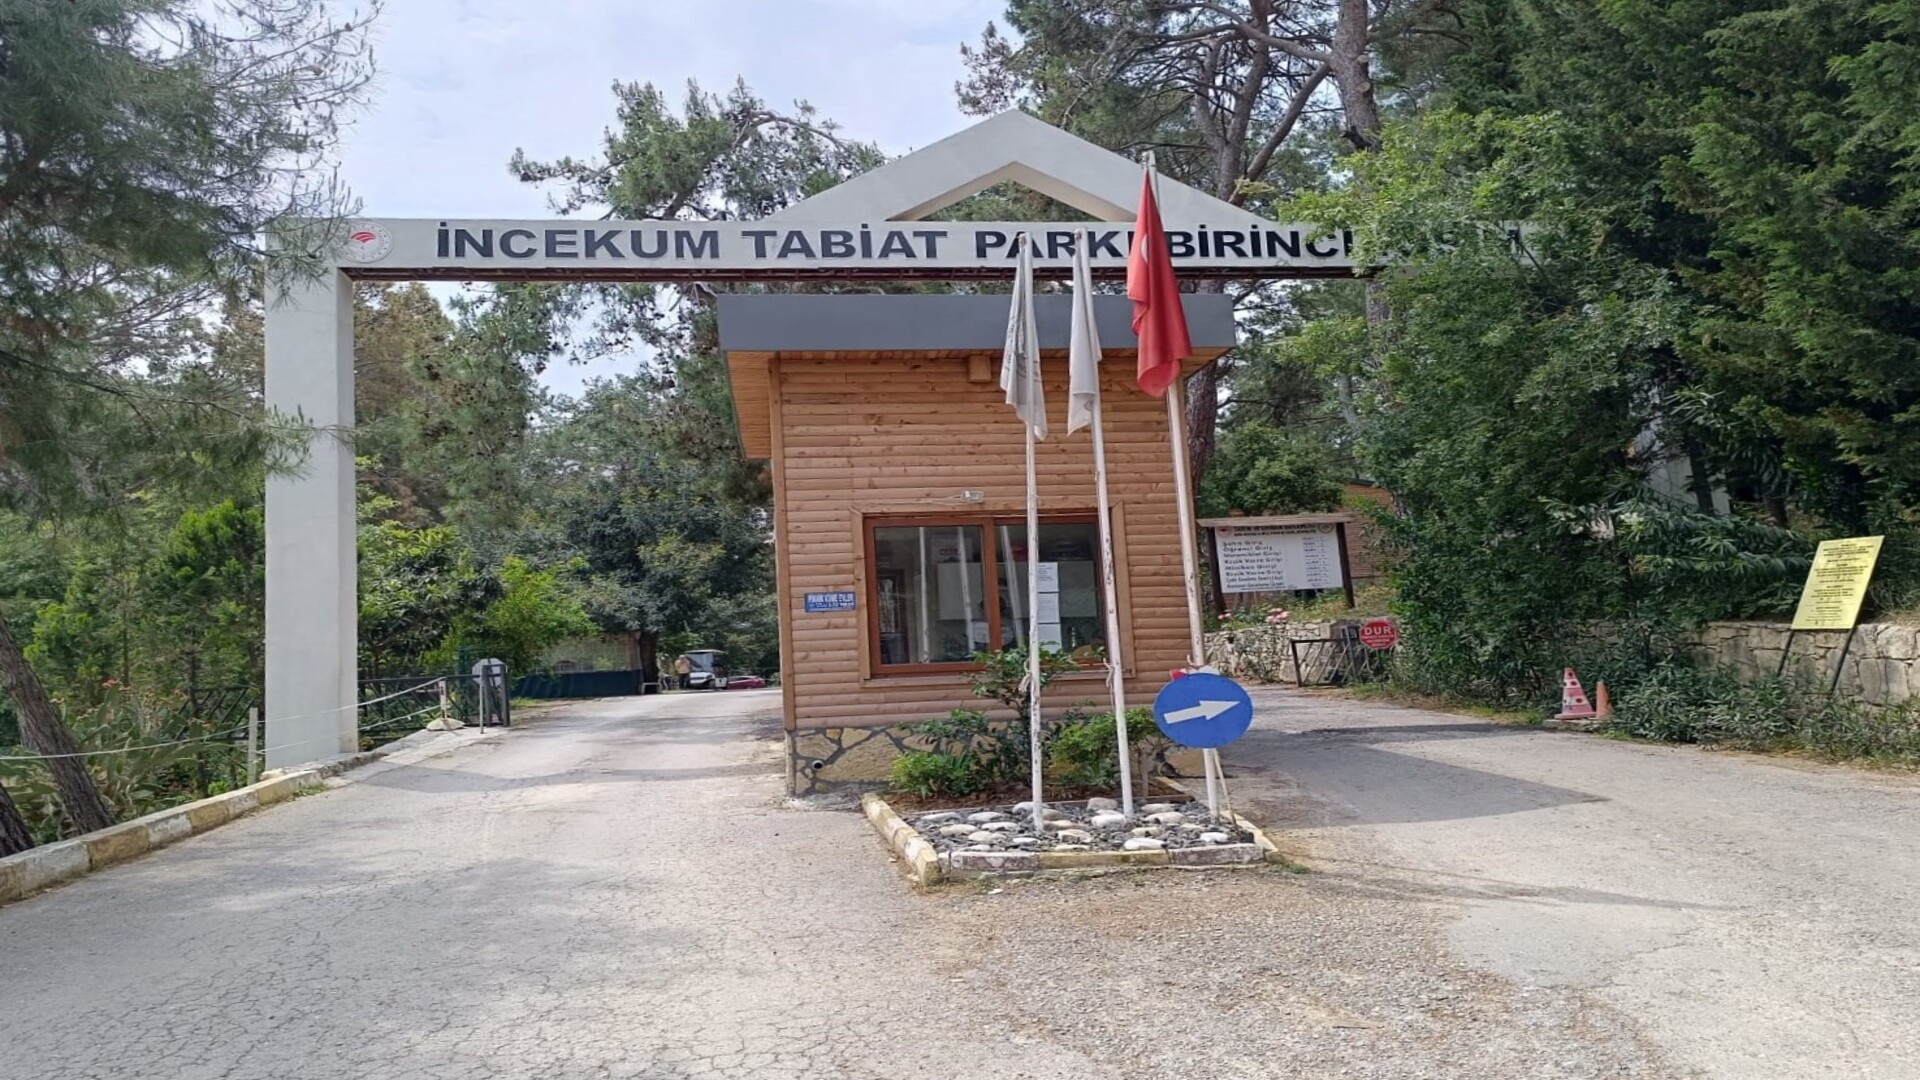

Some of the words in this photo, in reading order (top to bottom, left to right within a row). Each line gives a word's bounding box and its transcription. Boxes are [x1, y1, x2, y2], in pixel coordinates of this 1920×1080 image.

[436, 221, 720, 259] İNCEKUM
[742, 222, 948, 259] TABİAT
[1364, 626, 1391, 636] DUR
